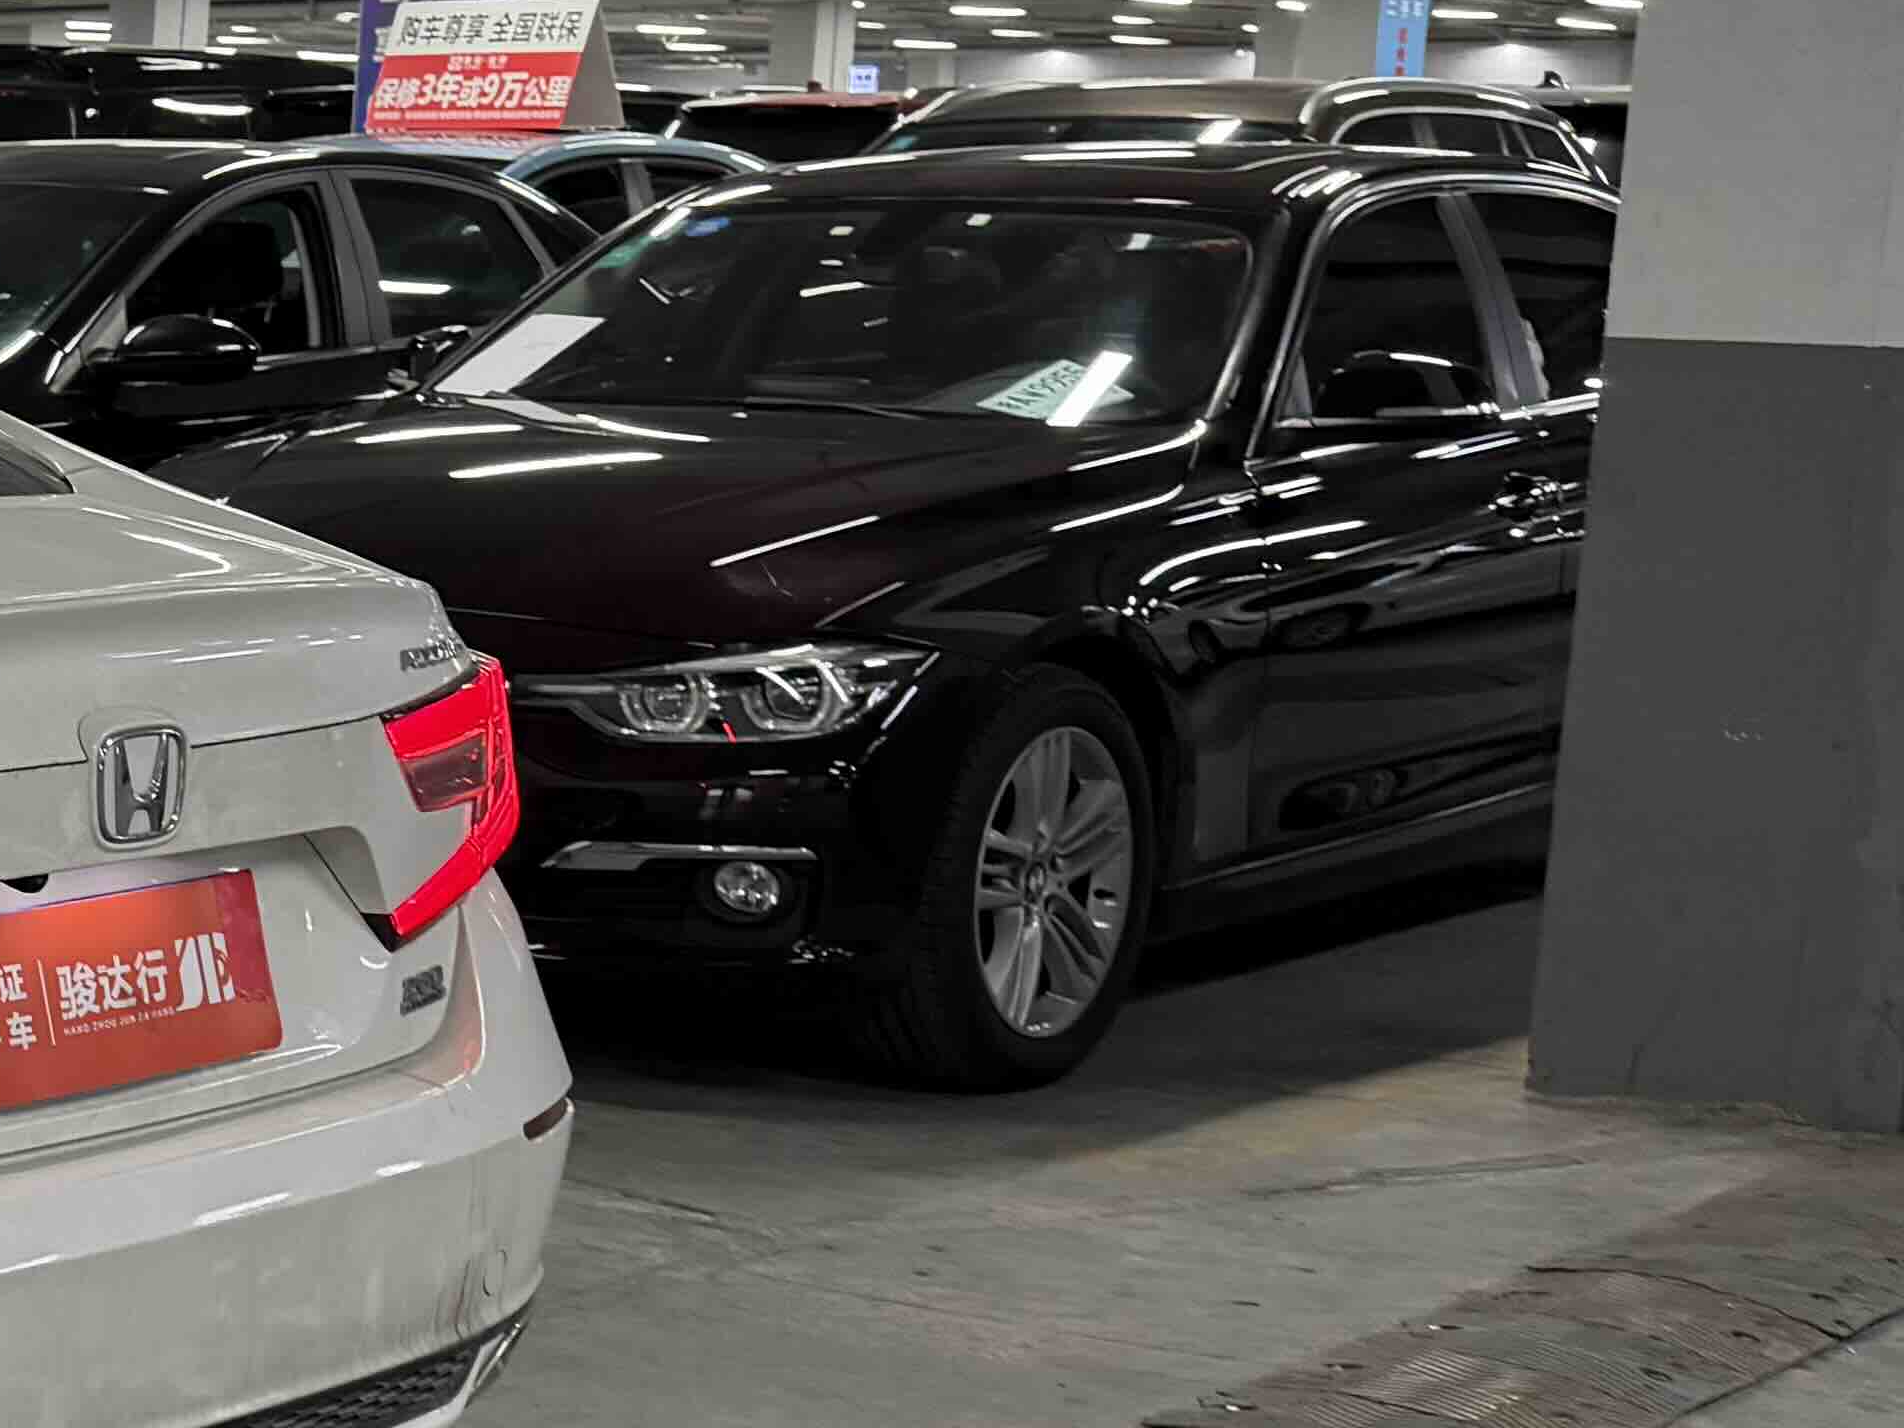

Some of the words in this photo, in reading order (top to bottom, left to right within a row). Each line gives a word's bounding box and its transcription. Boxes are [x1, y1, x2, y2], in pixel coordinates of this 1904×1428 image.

[401, 14, 489, 45] 购车尊享
[488, 11, 584, 43] 全国联保
[374, 71, 573, 109] 保修3年或9万公里
[55, 949, 168, 1021] 骏达行
